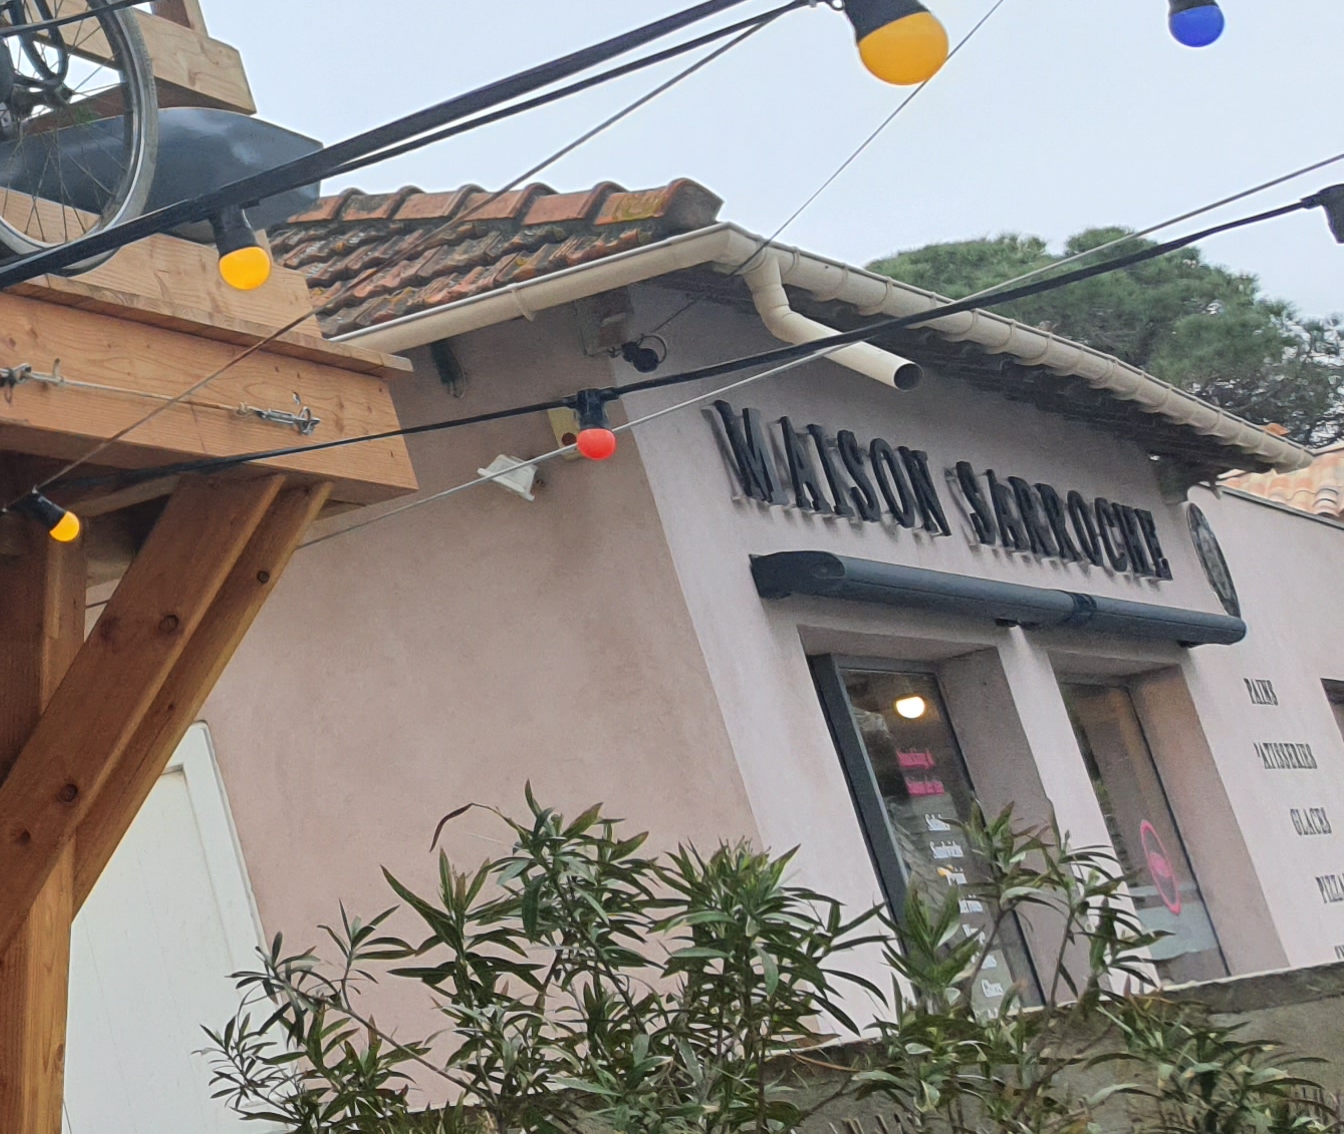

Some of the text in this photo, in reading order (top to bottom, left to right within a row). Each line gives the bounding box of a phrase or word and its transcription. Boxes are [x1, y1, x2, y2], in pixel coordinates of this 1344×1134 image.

[700, 399, 1173, 581] MAISON SARROCHE
[1243, 677, 1279, 706] PAINS
[1290, 807, 1332, 836] GLACES
